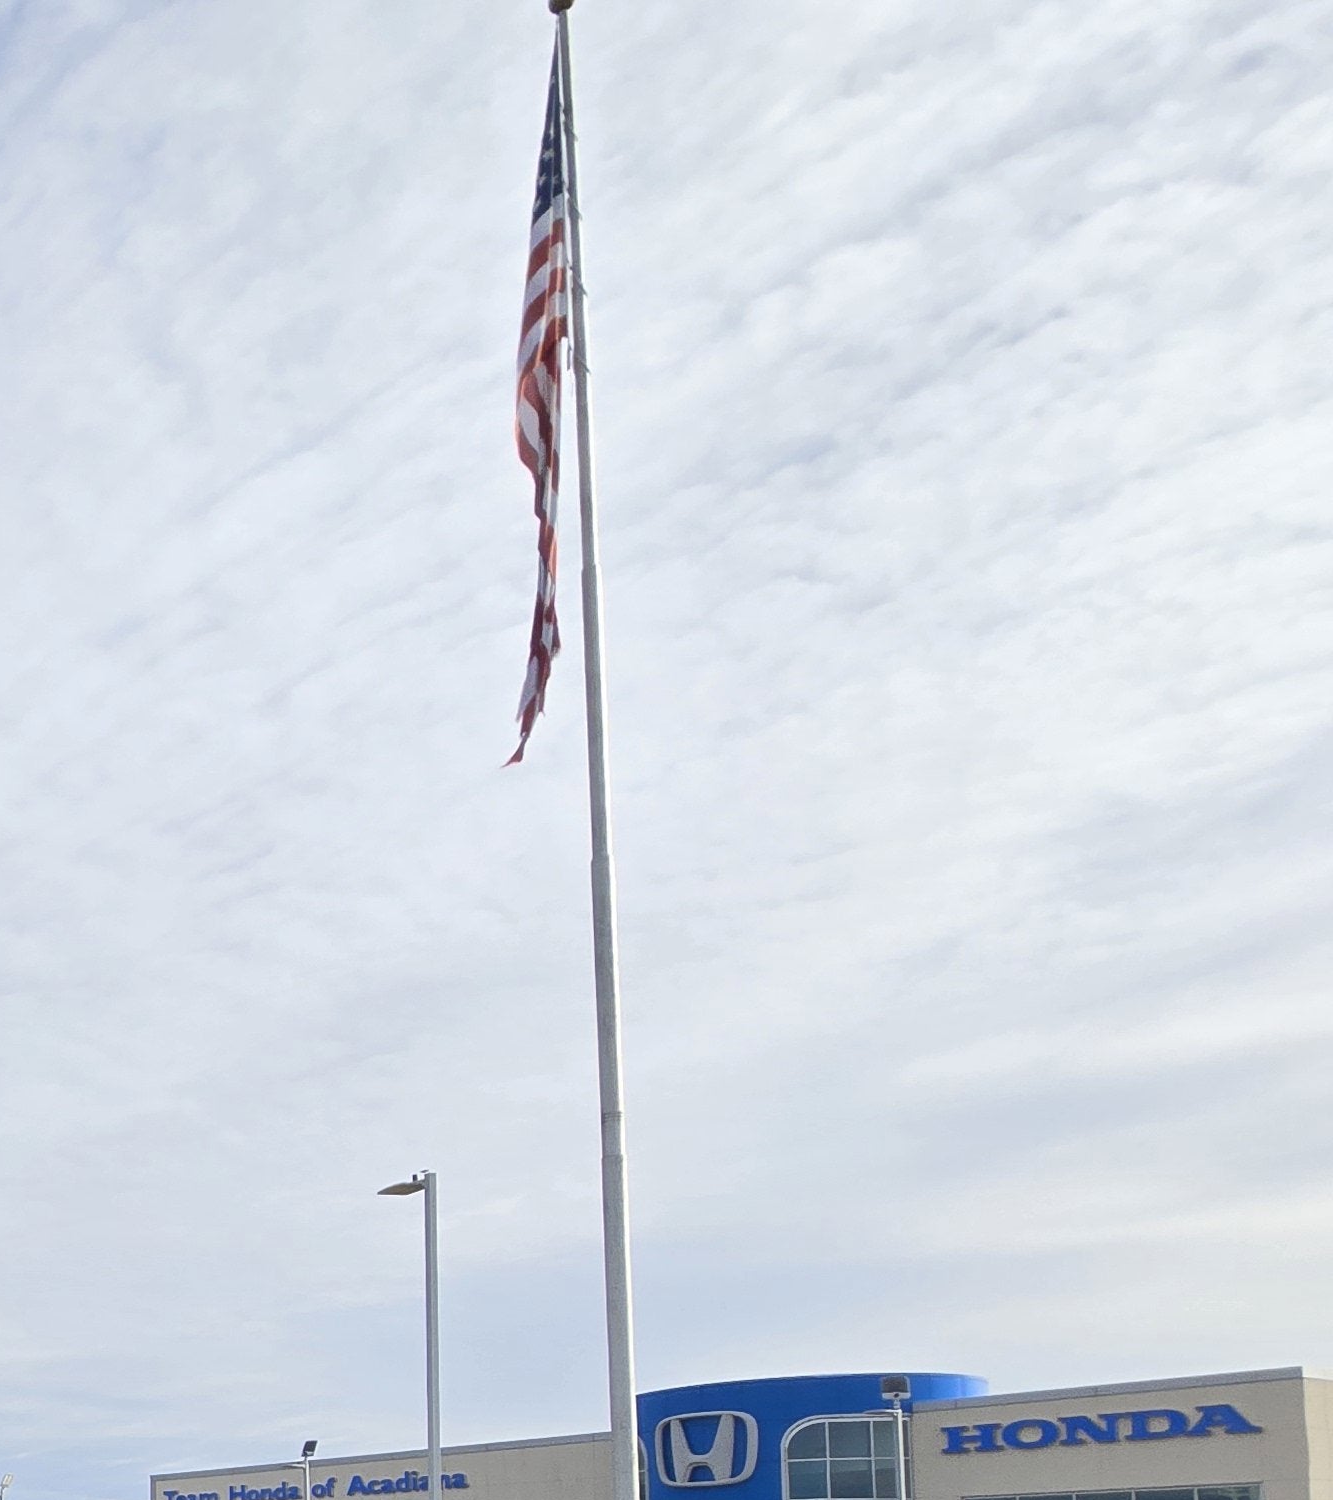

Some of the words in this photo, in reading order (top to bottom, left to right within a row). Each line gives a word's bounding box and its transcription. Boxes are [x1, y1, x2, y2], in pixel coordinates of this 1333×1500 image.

[939, 1403, 1262, 1455] HONDA
[312, 1477, 337, 1498] of
[347, 1470, 469, 1496] Acadiana
